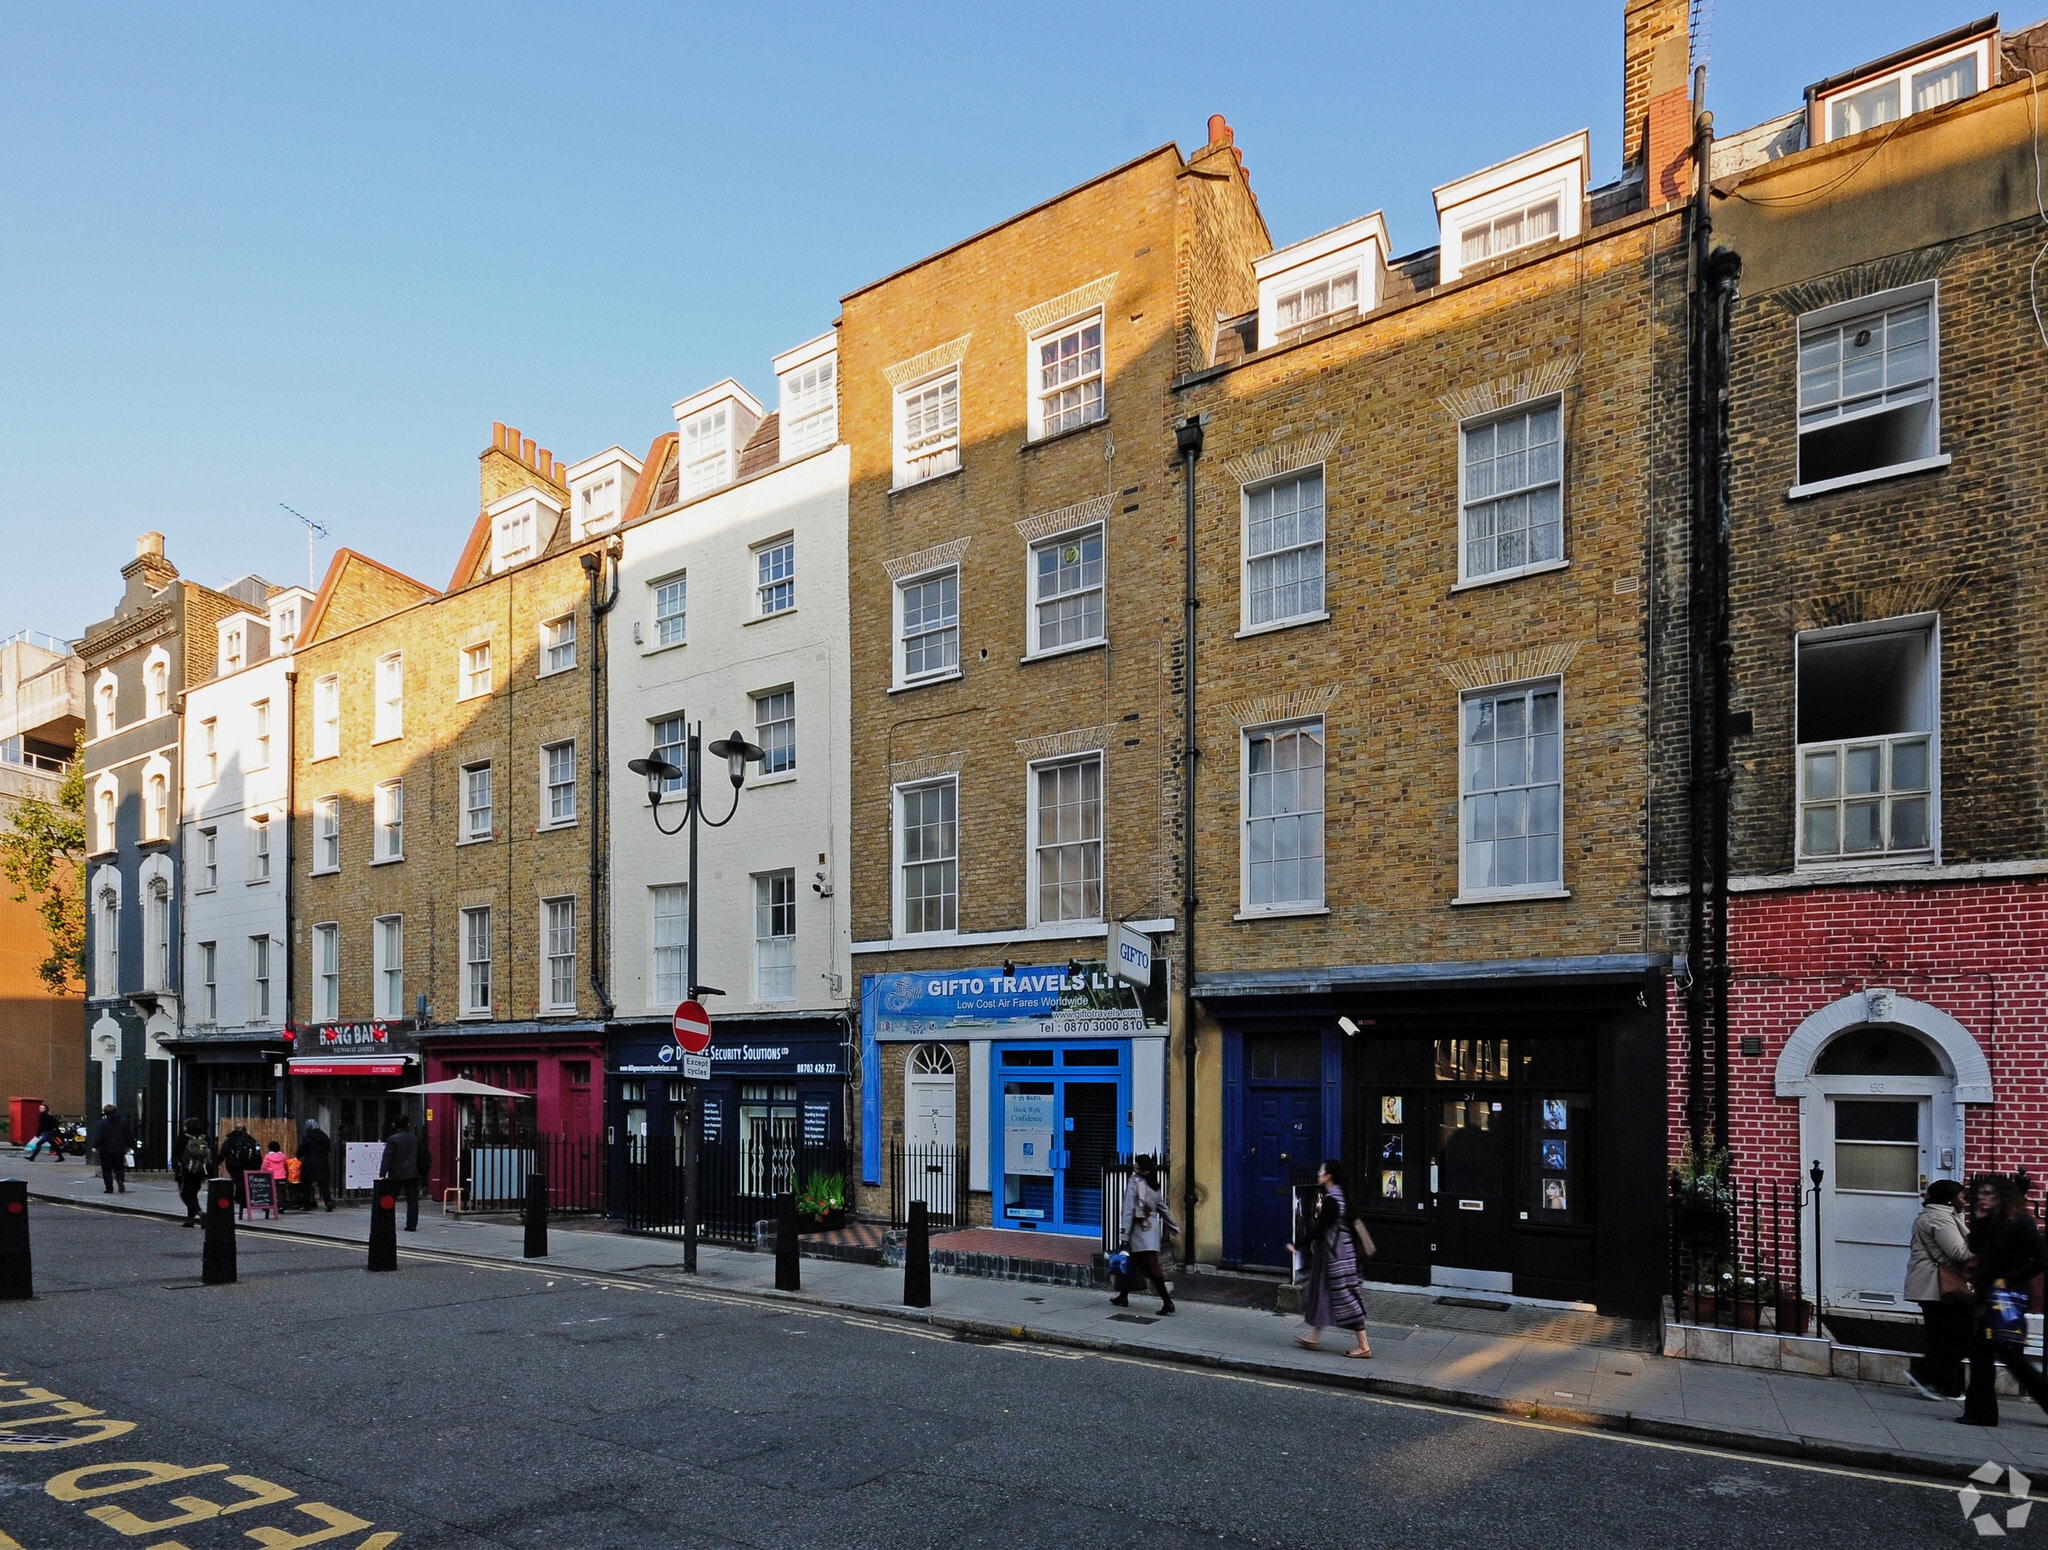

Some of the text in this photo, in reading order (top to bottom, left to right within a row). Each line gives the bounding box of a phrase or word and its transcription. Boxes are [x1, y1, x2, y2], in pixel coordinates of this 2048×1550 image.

[1120, 943, 1149, 969] GIFTO
[927, 978, 985, 997] GIFTO
[990, 973, 1085, 994] TRAVELS
[957, 996, 1089, 1010] Low Cost Air Fares Worldwide
[1052, 1008, 1143, 1019] www.giftotravels.com
[1039, 1022, 1054, 1033] Tel
[1064, 1021, 1089, 1032] 0870
[1093, 1021, 1119, 1032] 3000
[1123, 1020, 1143, 1031] 810
[710, 1044, 742, 1060] SECURITY
[743, 1044, 781, 1060] SOLUTIONS
[686, 1057, 709, 1067] Except
[687, 1067, 707, 1076] cycles
[826, 1063, 836, 1073] 727
[1464, 1091, 1475, 1101] 57
[1027, 1105, 1041, 1113] With
[1010, 1114, 1043, 1122] Confidence
